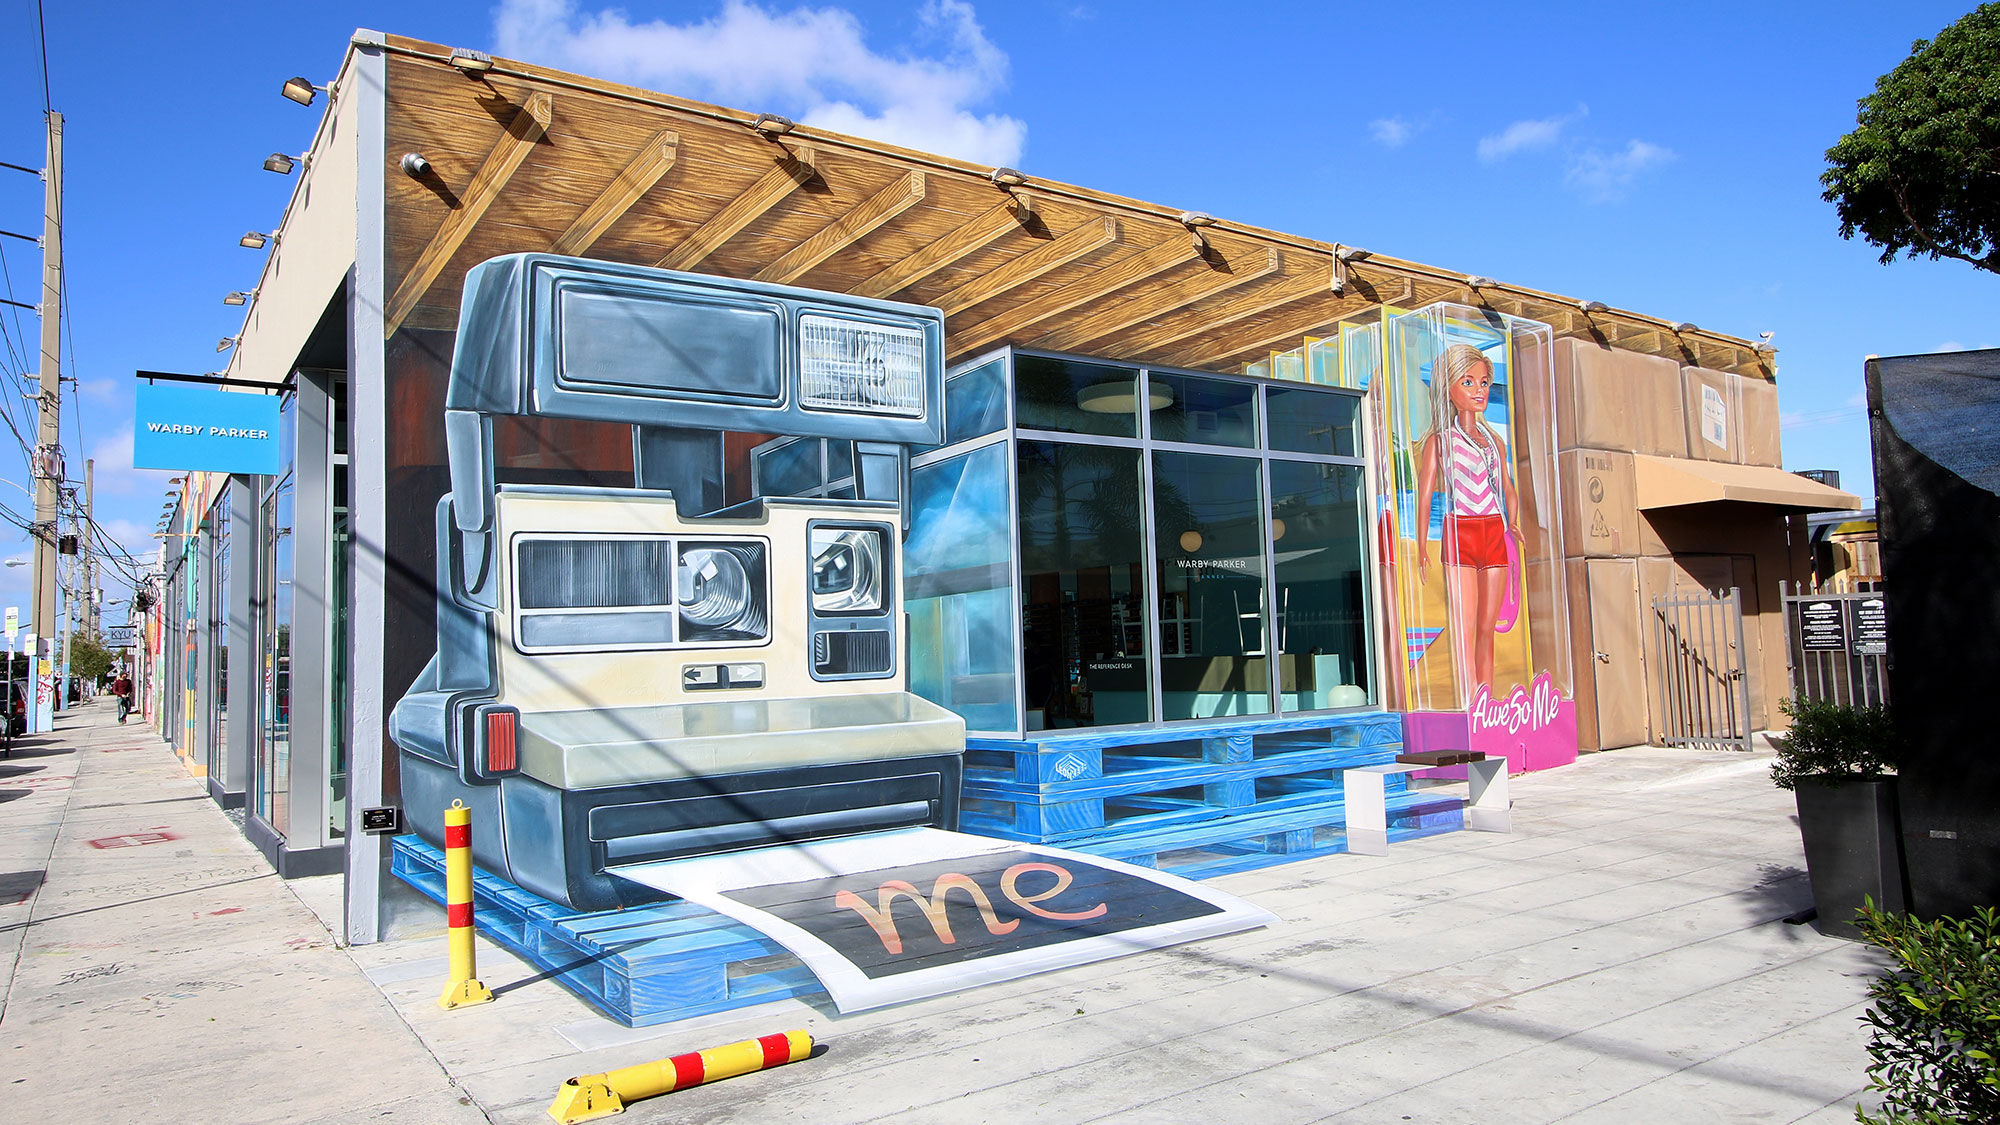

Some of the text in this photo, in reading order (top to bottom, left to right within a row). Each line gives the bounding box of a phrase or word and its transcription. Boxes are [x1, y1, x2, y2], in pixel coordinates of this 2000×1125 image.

[147, 421, 269, 440] WARBY PARKER
[1177, 560, 1247, 569] WARBY PARKER
[111, 630, 132, 641] KYU
[835, 862, 1108, 956] me
